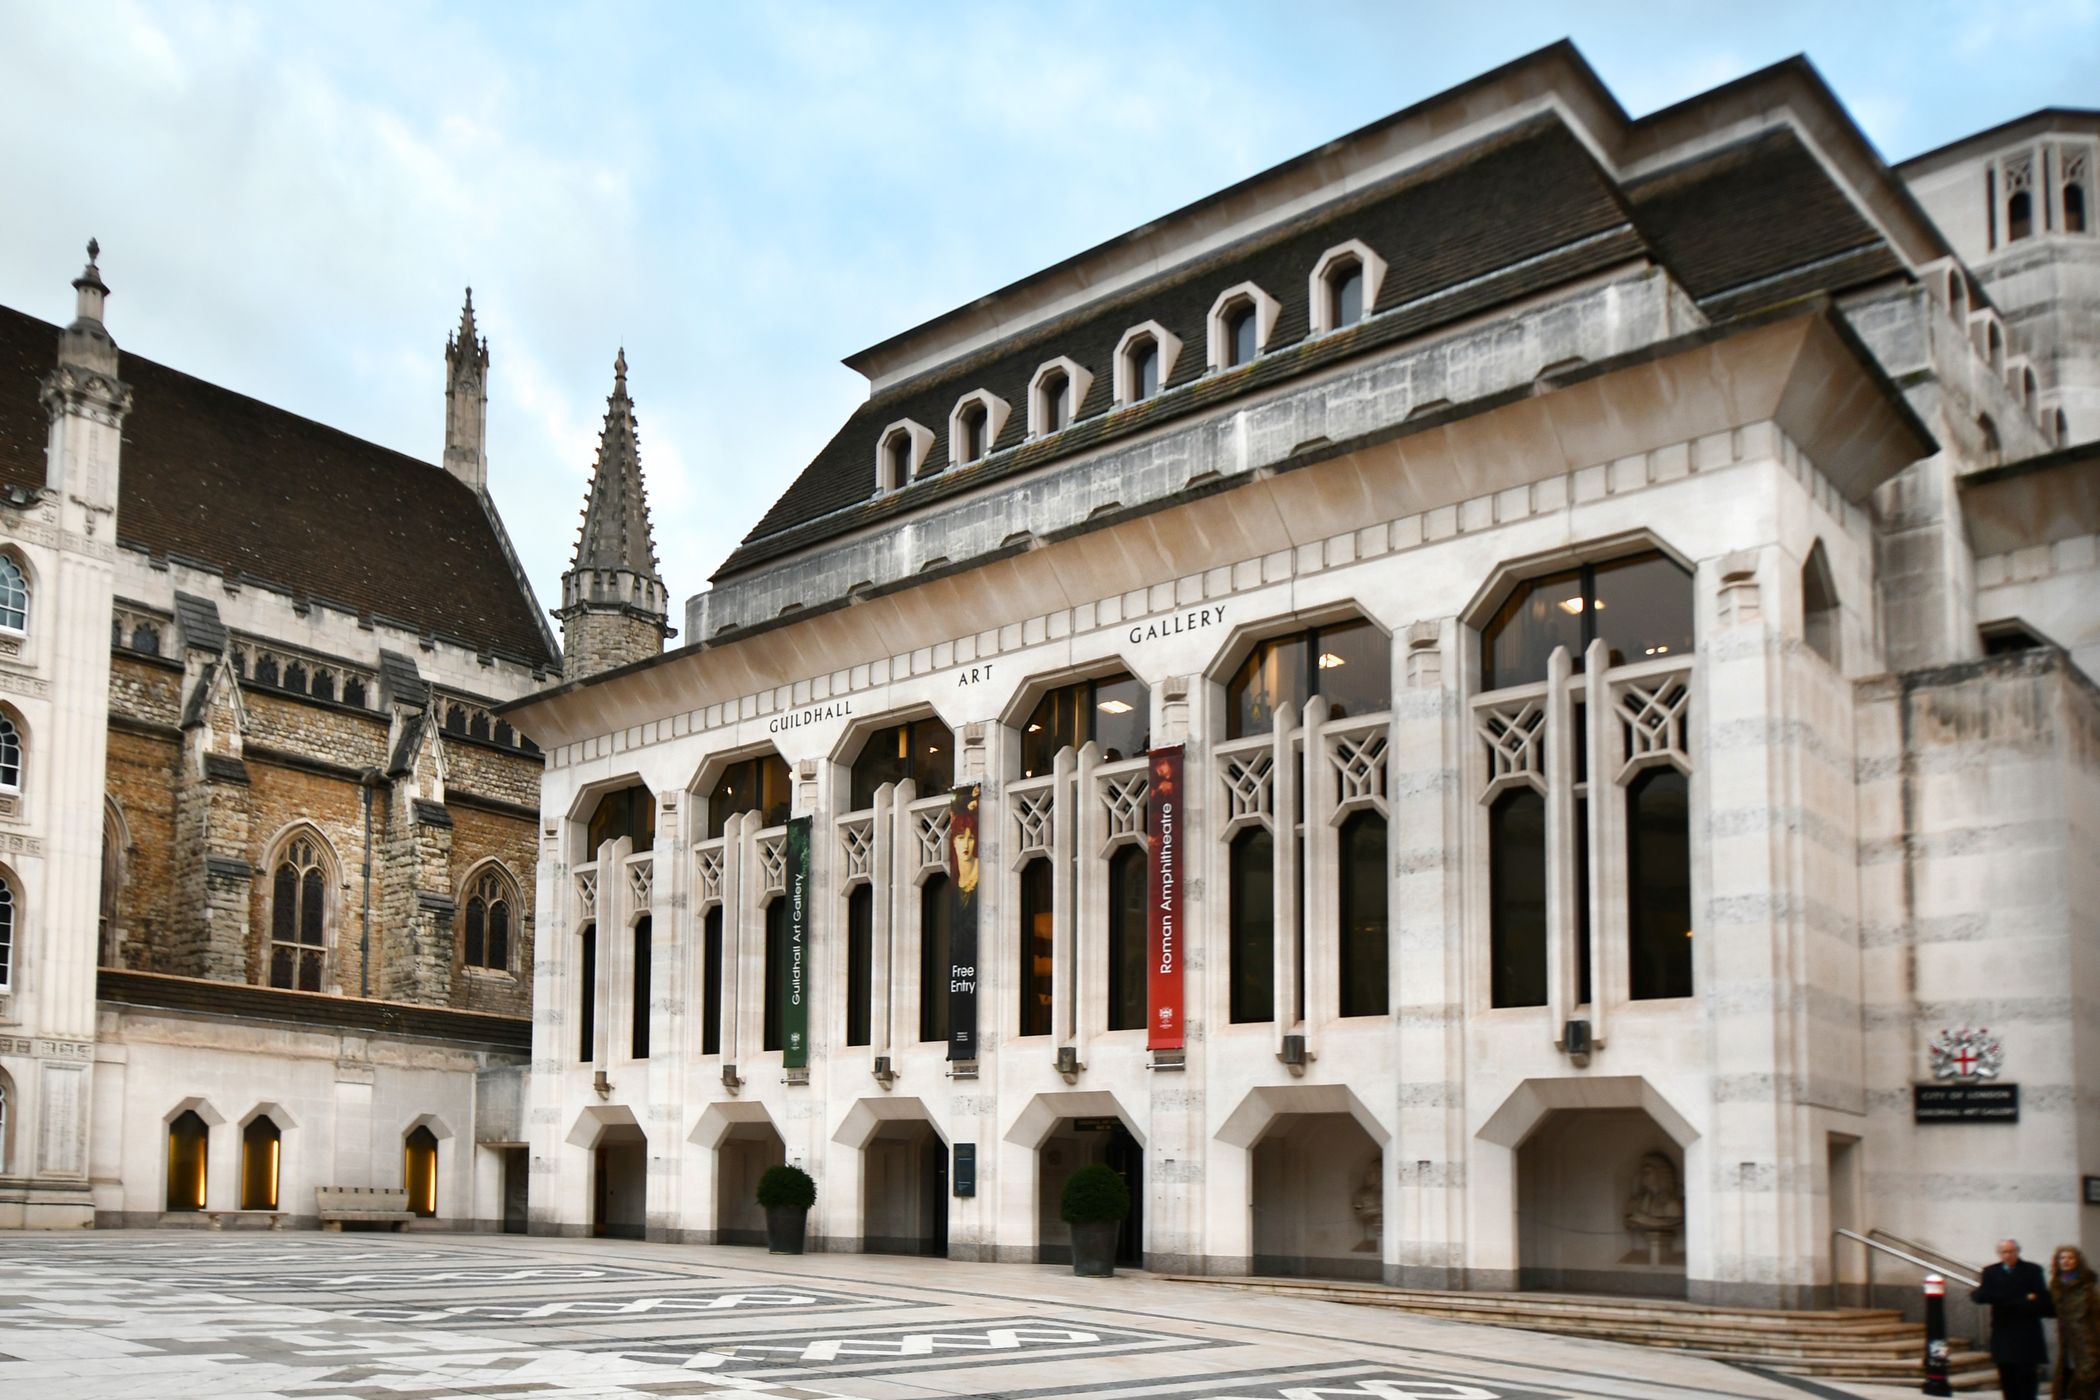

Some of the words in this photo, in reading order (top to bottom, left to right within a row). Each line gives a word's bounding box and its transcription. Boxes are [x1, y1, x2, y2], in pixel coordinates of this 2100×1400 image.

[769, 701, 853, 733] GUILDHALL
[958, 664, 993, 687] ART
[1129, 605, 1226, 644] GALLERY
[1160, 803, 1174, 911] Amphitheatre
[792, 874, 803, 922] Gallery
[792, 925, 801, 943] Art
[1160, 915, 1173, 974] Roman
[791, 945, 801, 1006] Guildhall
[950, 980, 976, 994] Entry
[952, 965, 975, 978] Free
